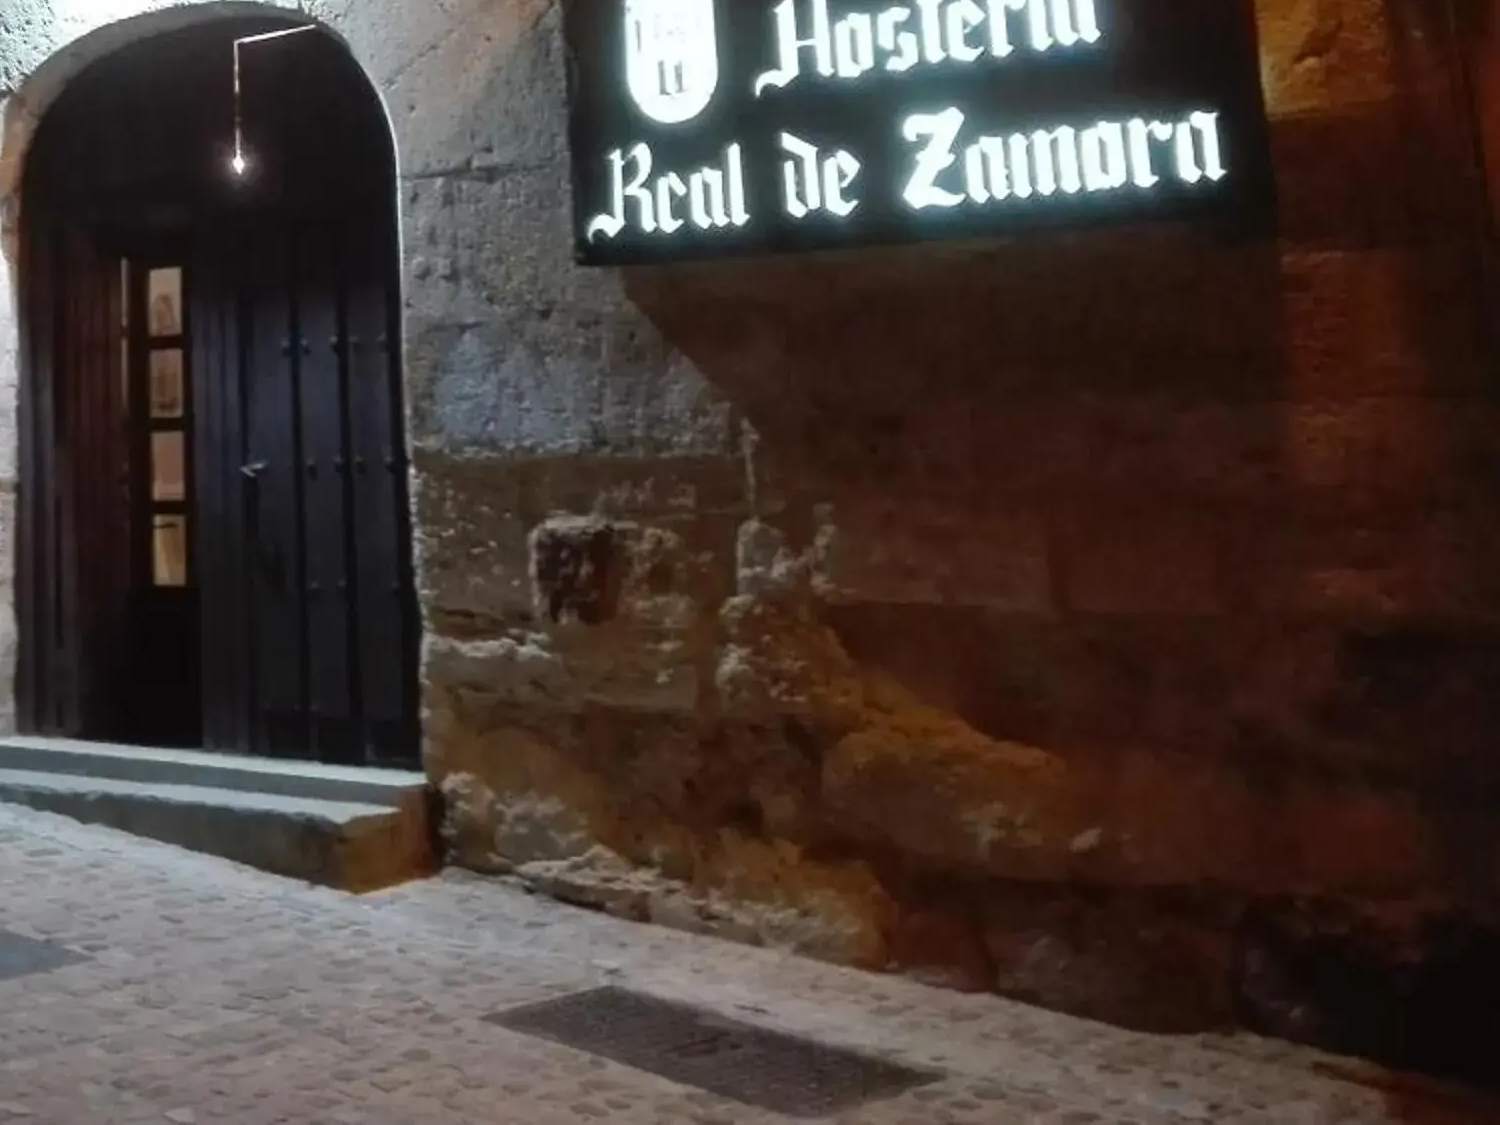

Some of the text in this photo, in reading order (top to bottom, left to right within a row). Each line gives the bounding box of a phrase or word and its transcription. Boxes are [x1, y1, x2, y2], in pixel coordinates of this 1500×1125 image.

[588, 106, 1227, 243] Real de Zamora
